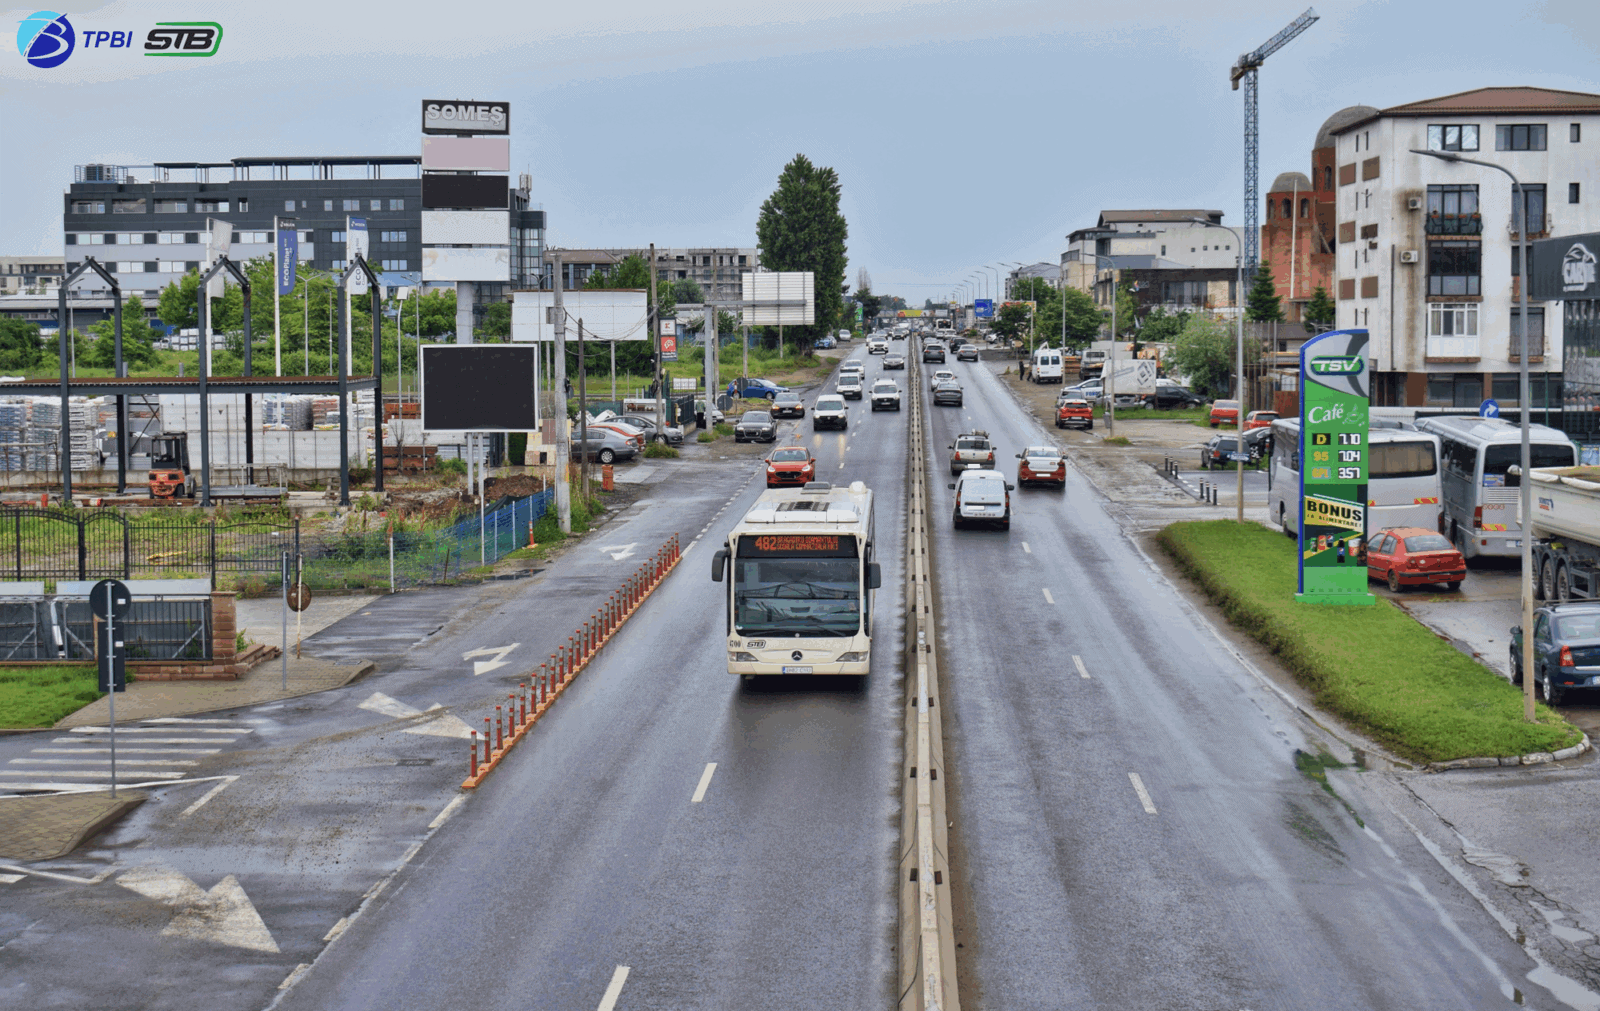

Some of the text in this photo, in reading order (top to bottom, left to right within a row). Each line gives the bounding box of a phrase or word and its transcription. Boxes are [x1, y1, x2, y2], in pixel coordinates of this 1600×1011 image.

[1311, 356, 1360, 372] TSV
[1308, 403, 1344, 424] Café
[1316, 434, 1327, 445] D
[1313, 451, 1329, 462] 95
[1307, 499, 1362, 521] BONUS
[755, 536, 777, 550] 482
